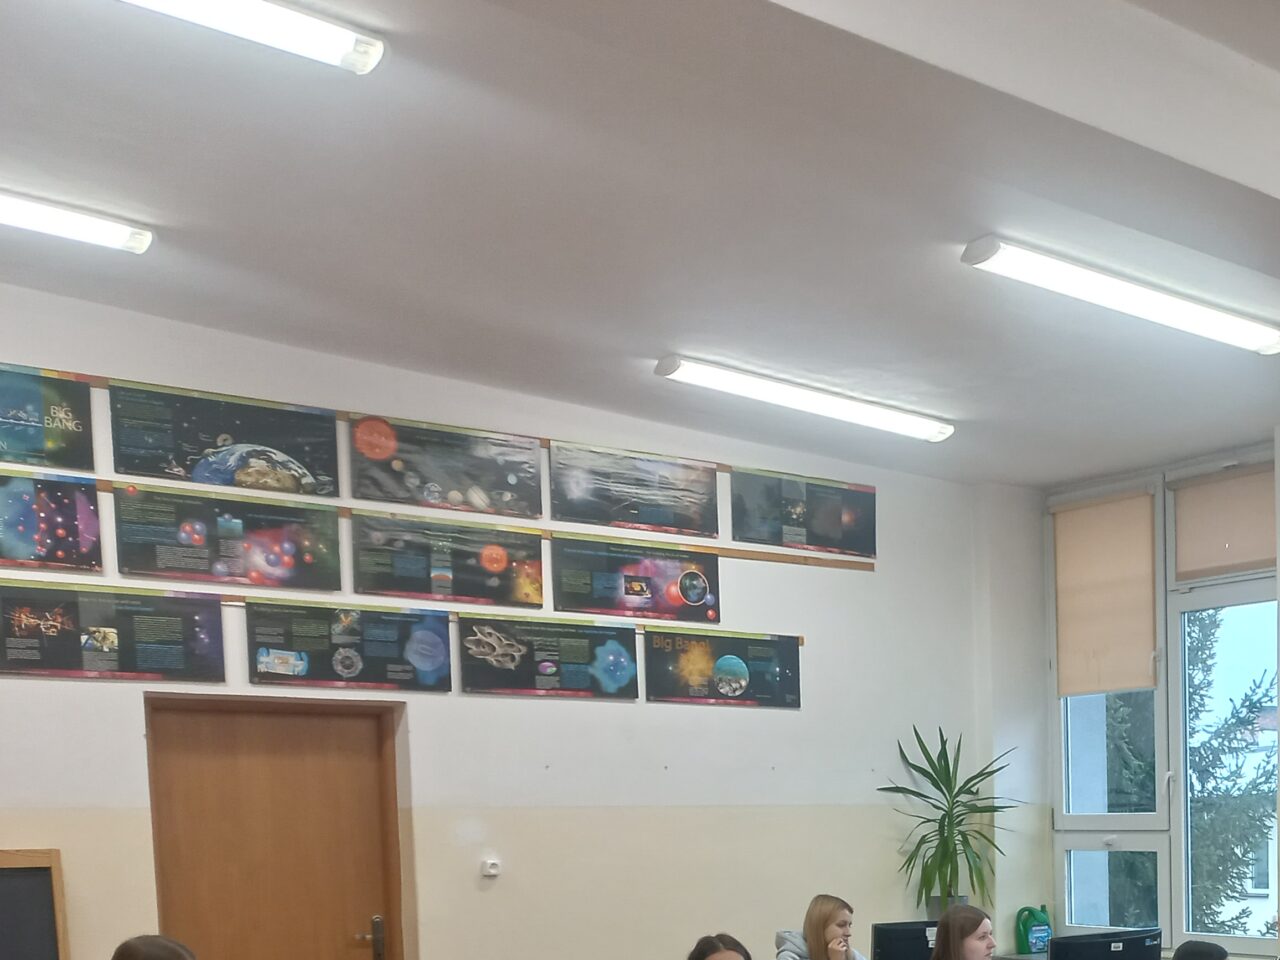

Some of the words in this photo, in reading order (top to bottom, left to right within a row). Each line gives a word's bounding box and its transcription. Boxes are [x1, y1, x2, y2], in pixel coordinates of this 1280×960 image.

[50, 405, 73, 420] BIG
[44, 416, 83, 432] BANG
[653, 635, 673, 652] Big
